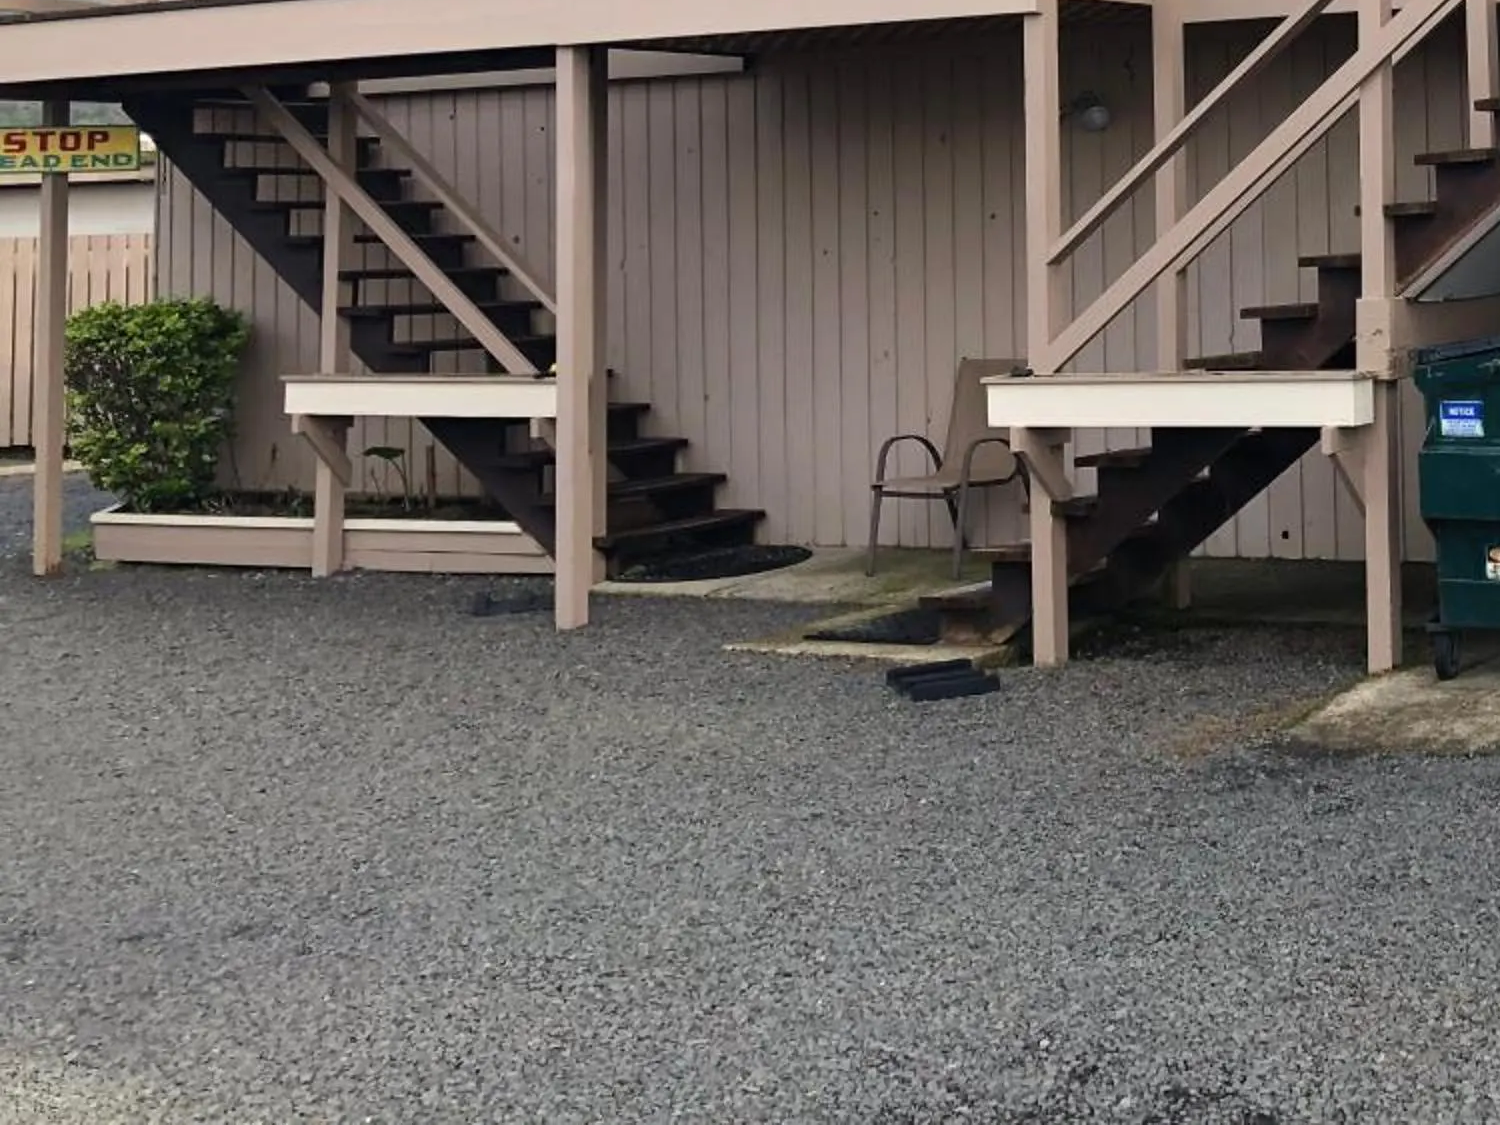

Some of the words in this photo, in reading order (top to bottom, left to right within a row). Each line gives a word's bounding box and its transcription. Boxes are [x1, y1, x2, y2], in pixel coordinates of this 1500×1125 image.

[3, 130, 109, 153] STOP
[0, 154, 61, 169] EAD
[71, 153, 132, 168] END
